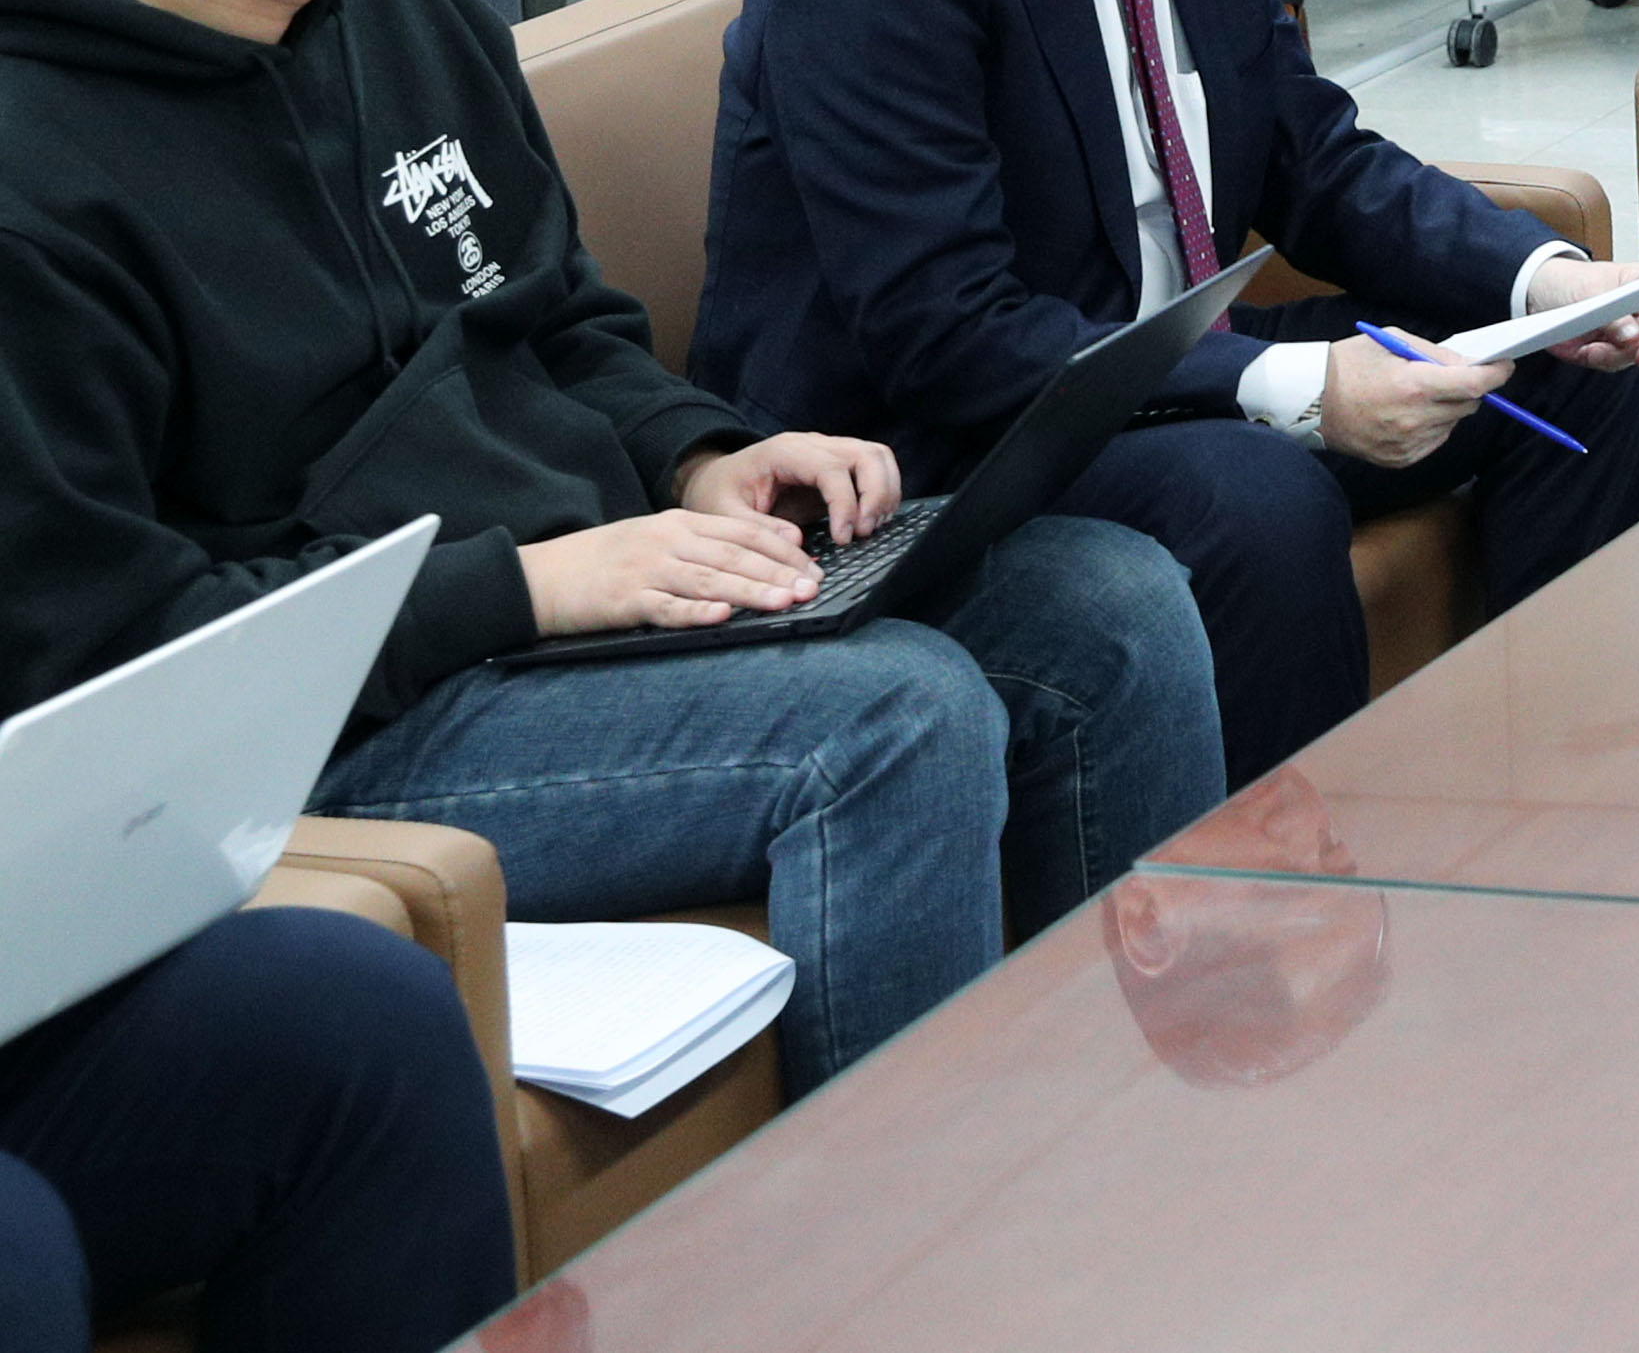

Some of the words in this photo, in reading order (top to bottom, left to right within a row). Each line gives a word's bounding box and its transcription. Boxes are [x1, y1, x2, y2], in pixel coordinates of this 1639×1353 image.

[425, 200, 451, 220] NEW
[425, 216, 449, 237] LOS
[461, 260, 502, 295] LONDON
[472, 273, 506, 299] PARIS
